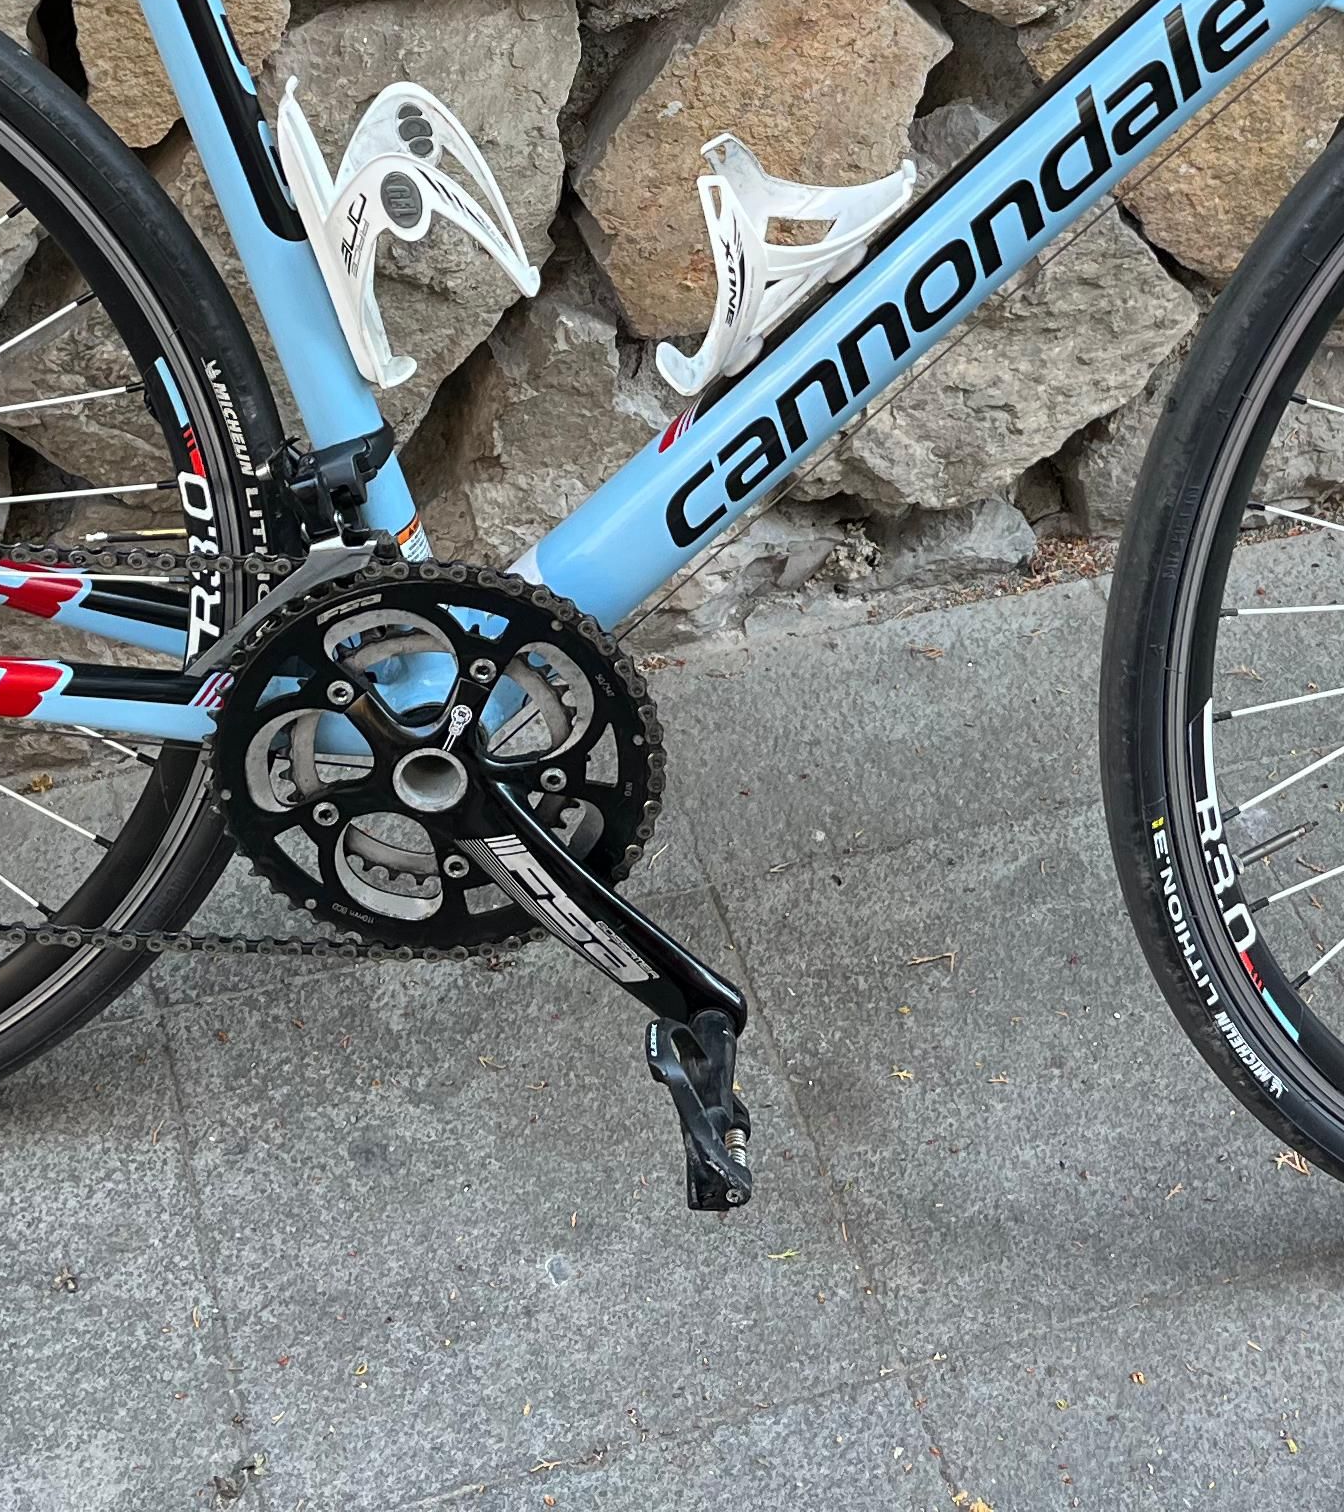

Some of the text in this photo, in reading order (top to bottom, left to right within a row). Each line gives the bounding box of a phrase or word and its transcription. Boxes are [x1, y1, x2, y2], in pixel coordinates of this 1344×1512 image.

[212, 382, 255, 477] MICHELIN
[1194, 797, 1257, 952] R3.0
[1152, 828, 1279, 1088] MICHELIN LITHION.3
